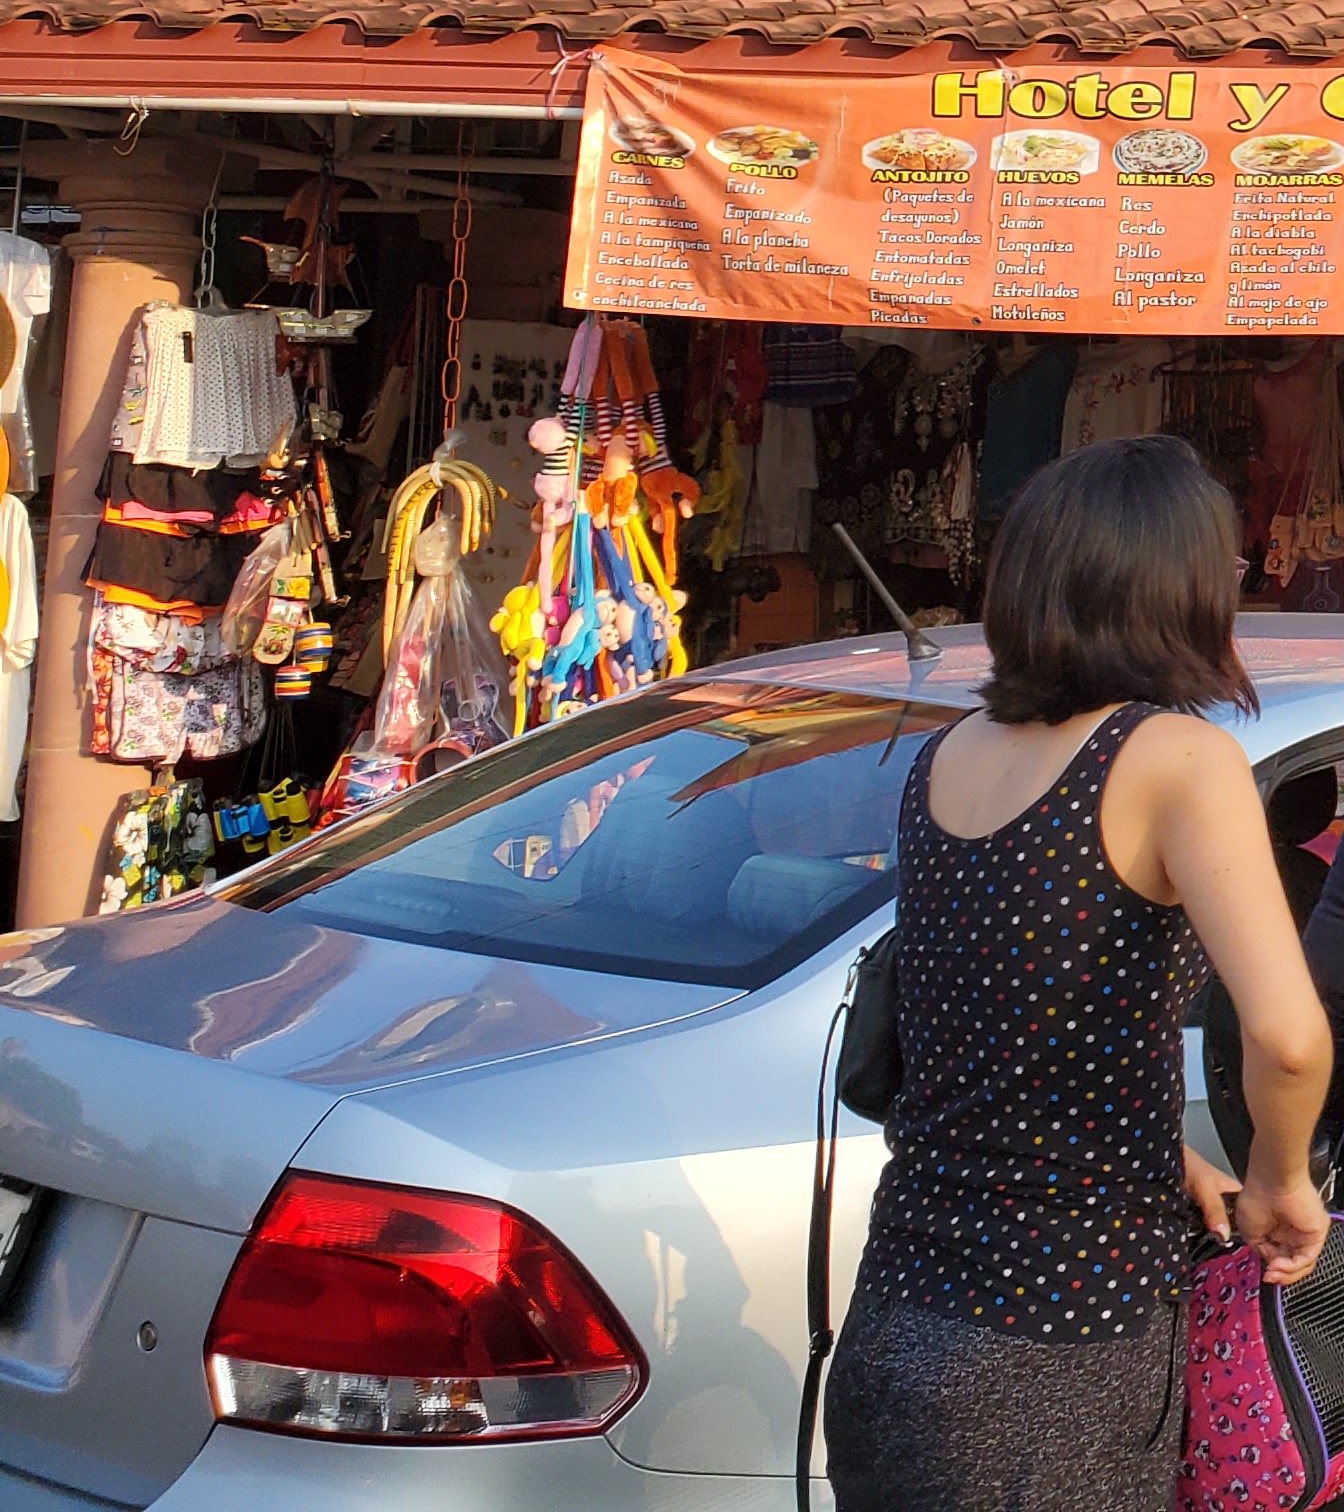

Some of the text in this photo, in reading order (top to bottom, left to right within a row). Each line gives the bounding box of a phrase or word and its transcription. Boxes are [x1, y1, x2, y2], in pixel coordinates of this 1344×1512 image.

[930, 71, 1197, 121] Hotel
[1228, 81, 1290, 131] y
[611, 151, 685, 169] CARNES
[729, 162, 798, 179] POLLO
[872, 169, 970, 183] ANTOJITO
[997, 170, 1081, 184] HUEVOS
[725, 178, 765, 196] Frito
[1117, 172, 1214, 187] MEMELAS
[1234, 173, 1344, 189] MOJARRAS
[956, 189, 973, 203] de
[1002, 191, 1106, 208] A la mexicana
[1120, 196, 1153, 211] Res
[724, 203, 812, 226] Empanizado
[881, 208, 960, 228] desayunos)
[999, 214, 1045, 230] Jamón
[1119, 219, 1166, 235] Cerdo
[721, 229, 809, 252] A la plancha
[878, 230, 981, 244] Tacos Dorados
[997, 237, 1074, 258] Longaniza
[1116, 242, 1161, 259] Pollo
[721, 254, 849, 276] Torta de milaneza
[875, 250, 970, 265] Entomatadas
[996, 259, 1046, 275] Omelet
[870, 269, 964, 289] Enfrijoladas
[1114, 267, 1205, 289] Longaniza
[868, 289, 952, 305] Empanadas
[993, 282, 1079, 299] Estrellados
[1113, 290, 1197, 312] Al pastor
[869, 309, 928, 324] Picadas
[991, 305, 1065, 321] Motuleños
